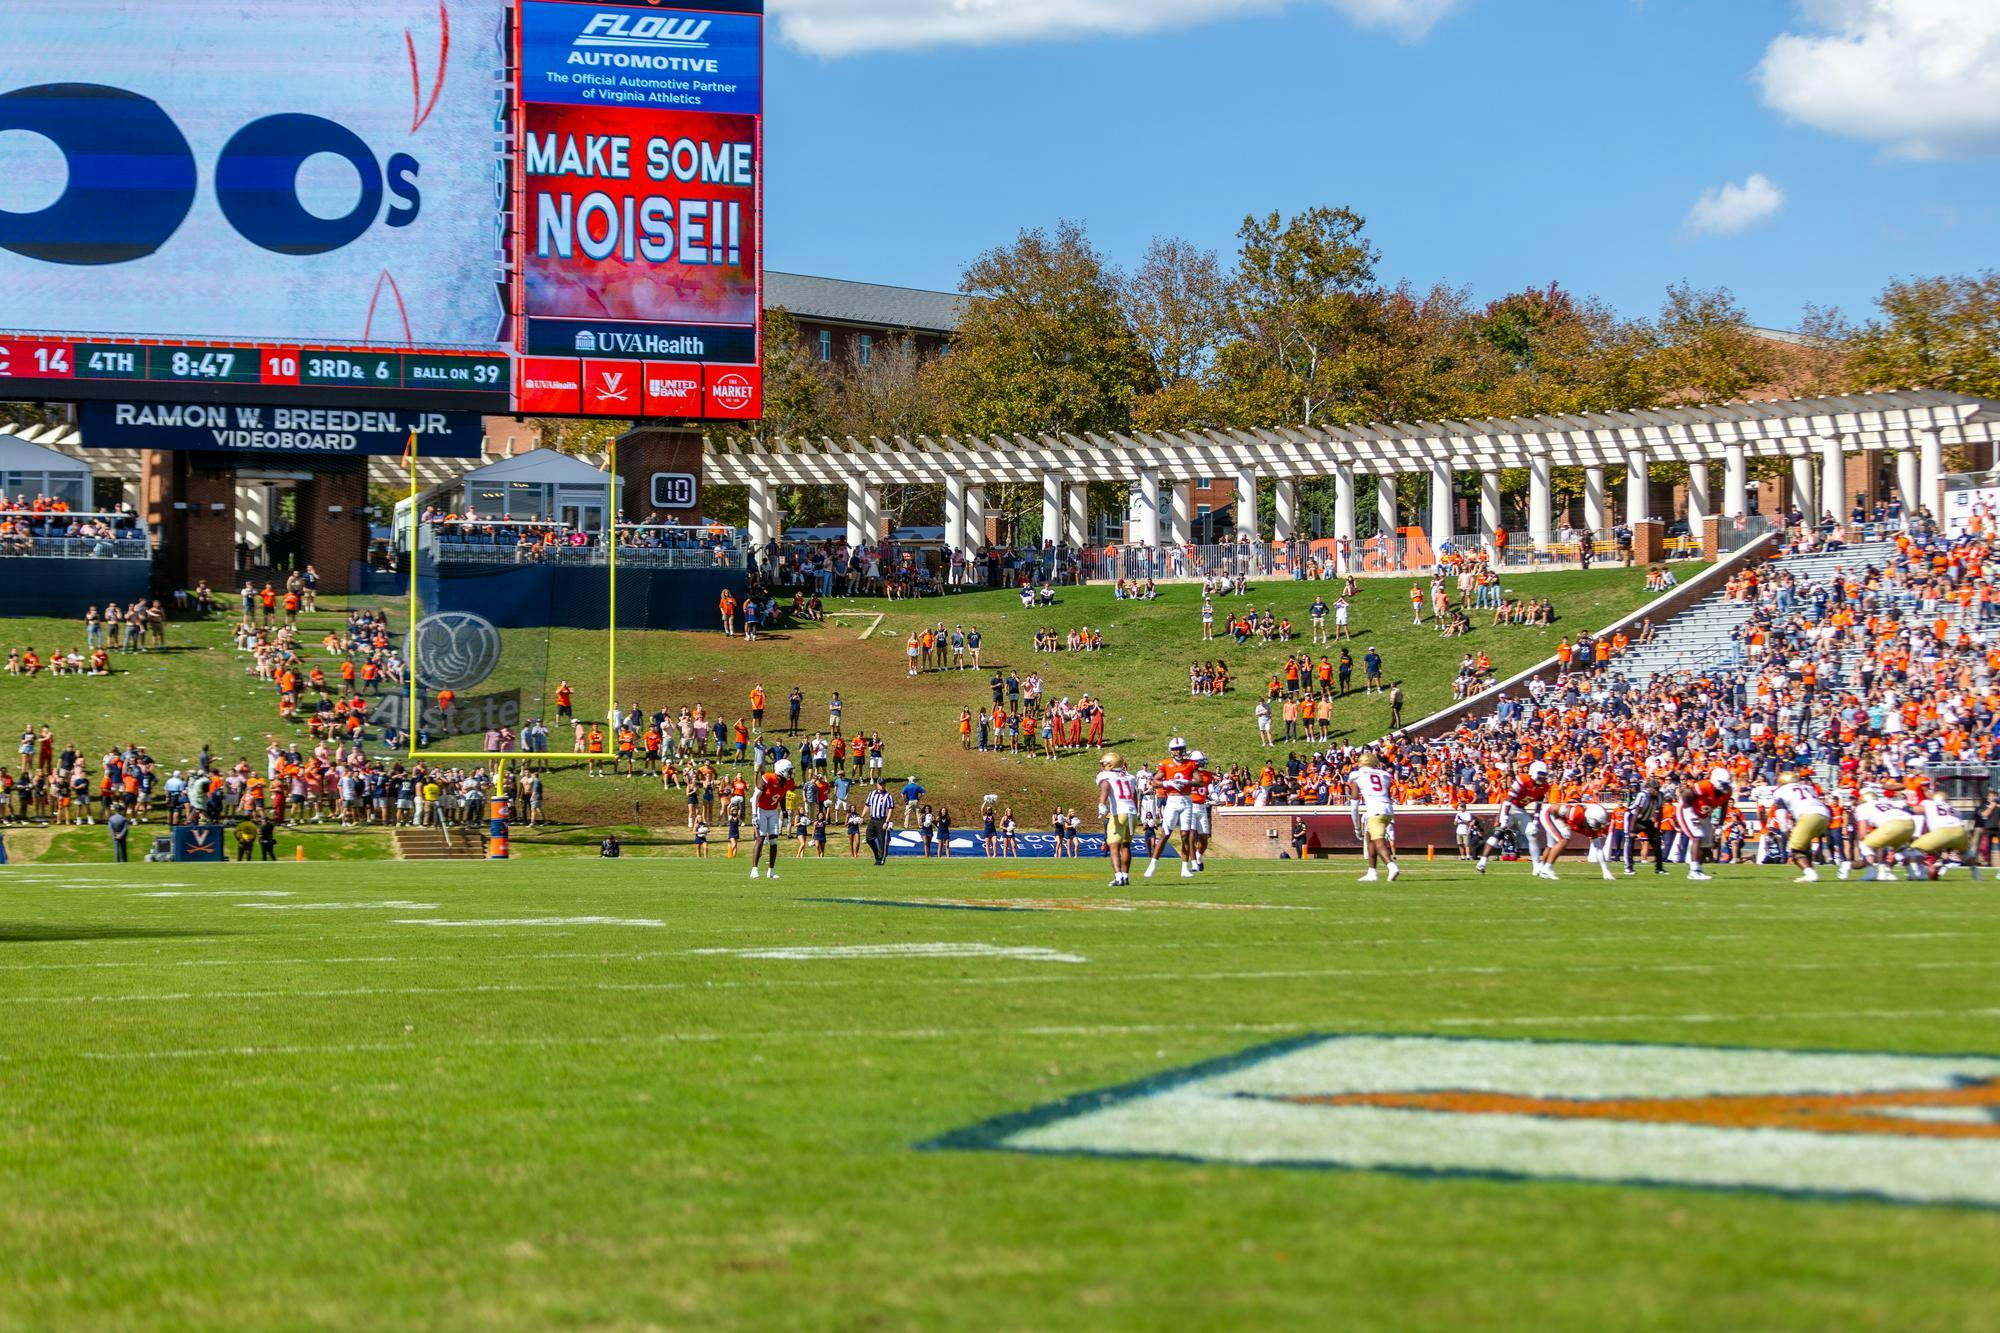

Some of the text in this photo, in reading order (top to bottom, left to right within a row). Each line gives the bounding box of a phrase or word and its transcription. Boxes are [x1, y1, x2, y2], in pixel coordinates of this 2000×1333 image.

[581, 13, 713, 41] FLOW
[566, 51, 719, 73] AUTOMOTIVE
[546, 71, 737, 93] The Official Automotive Partner
[582, 87, 702, 105] of Virginia Athletics
[526, 131, 753, 185] MAKE SOME
[537, 191, 740, 266] NOISE!!
[34, 348, 69, 373] 14
[88, 351, 135, 372] 4TH
[171, 352, 236, 377] 8:47
[268, 357, 296, 377] 10
[375, 361, 390, 379] 6
[413, 366, 448, 379] BALL
[449, 368, 469, 380] ON
[473, 364, 500, 383] 39
[660, 379, 697, 390] UNITED
[660, 388, 688, 398] BANK
[712, 385, 753, 398] MARKET
[115, 404, 227, 427] RAMON
[235, 407, 265, 429] W.
[408, 413, 453, 434] JR.
[211, 430, 357, 450] VIDEOBOARD
[667, 479, 688, 501] 10
[369, 694, 520, 735] Allstate
[1116, 779, 1134, 799] 11
[1370, 774, 1383, 792] 9
